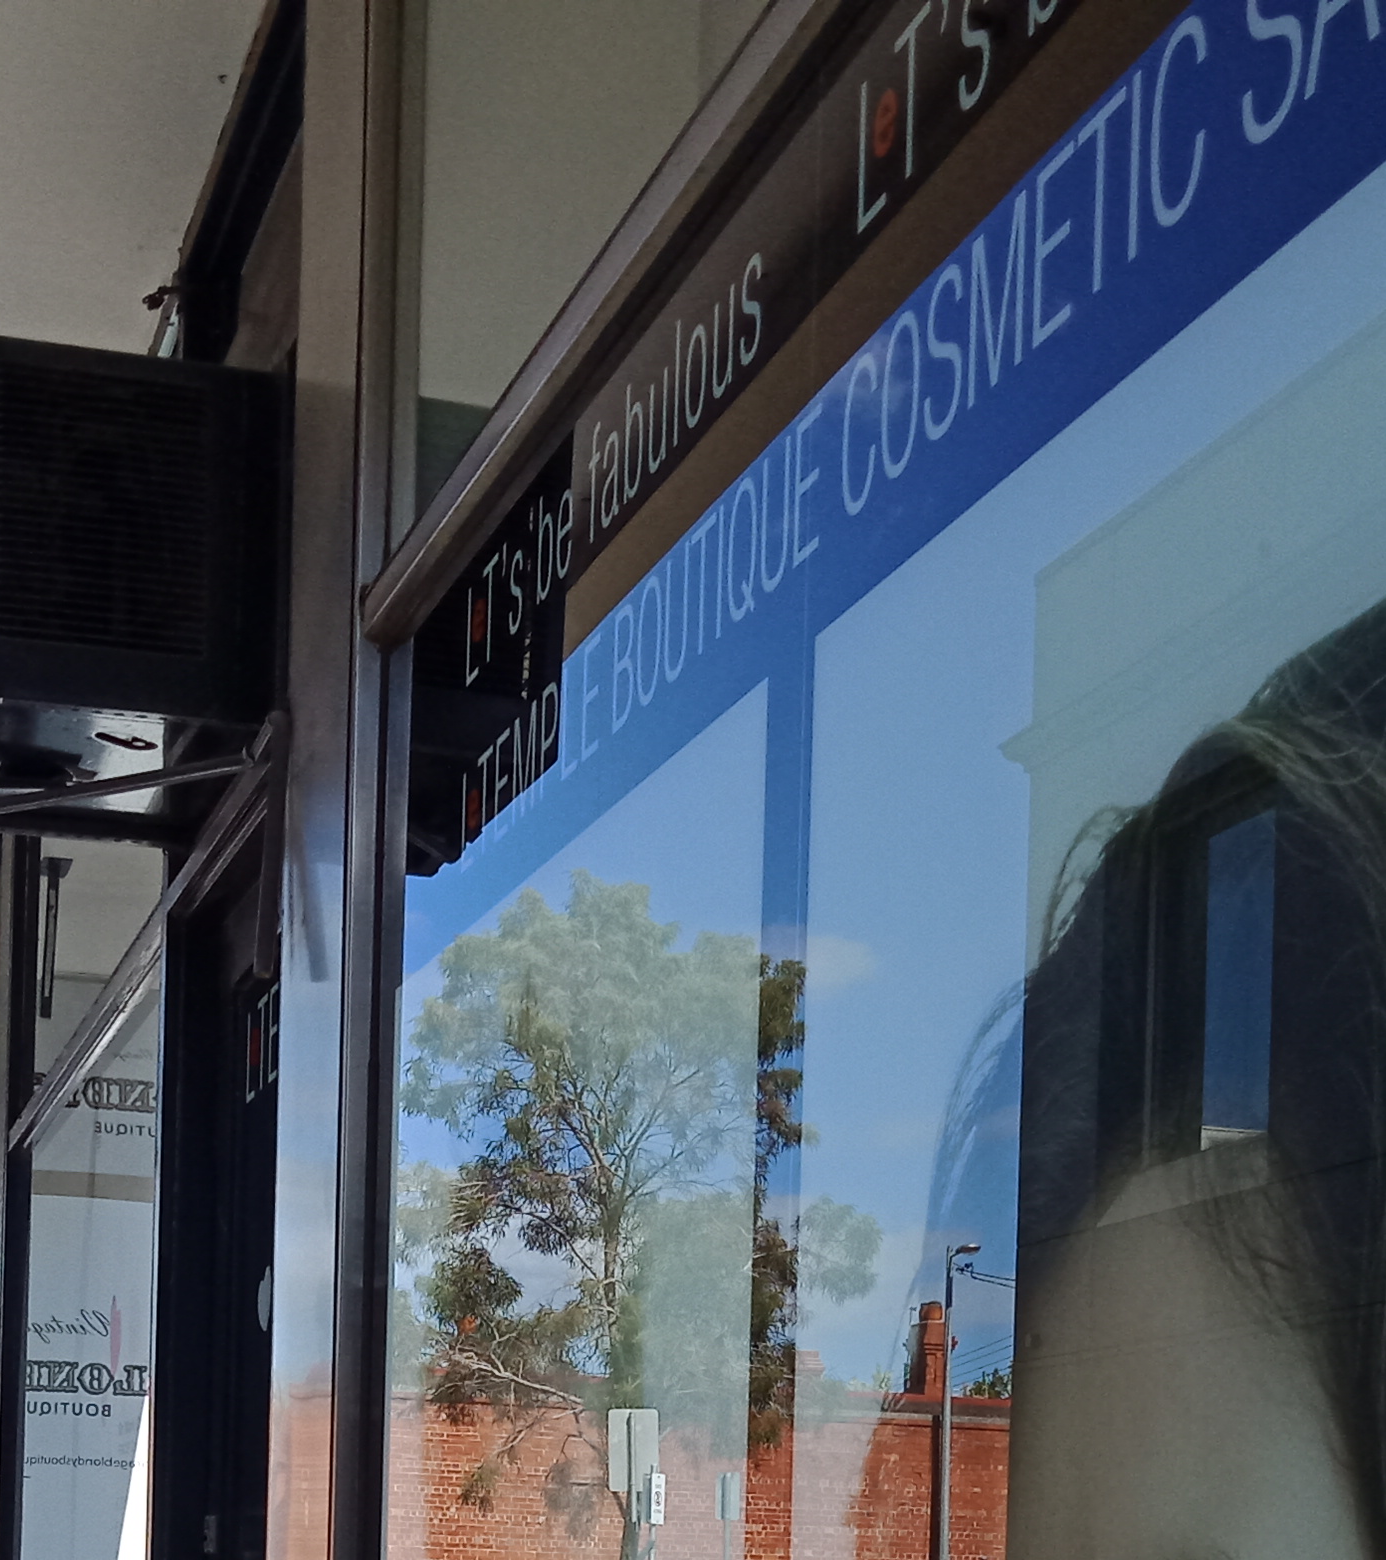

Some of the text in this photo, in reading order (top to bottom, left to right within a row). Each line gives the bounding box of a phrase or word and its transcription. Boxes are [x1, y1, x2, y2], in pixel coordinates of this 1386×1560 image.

[535, 488, 574, 605] be
[588, 252, 762, 544] fabulous
[612, 404, 822, 736] BOUTIQUE
[841, 15, 1207, 516] COSMETIC
